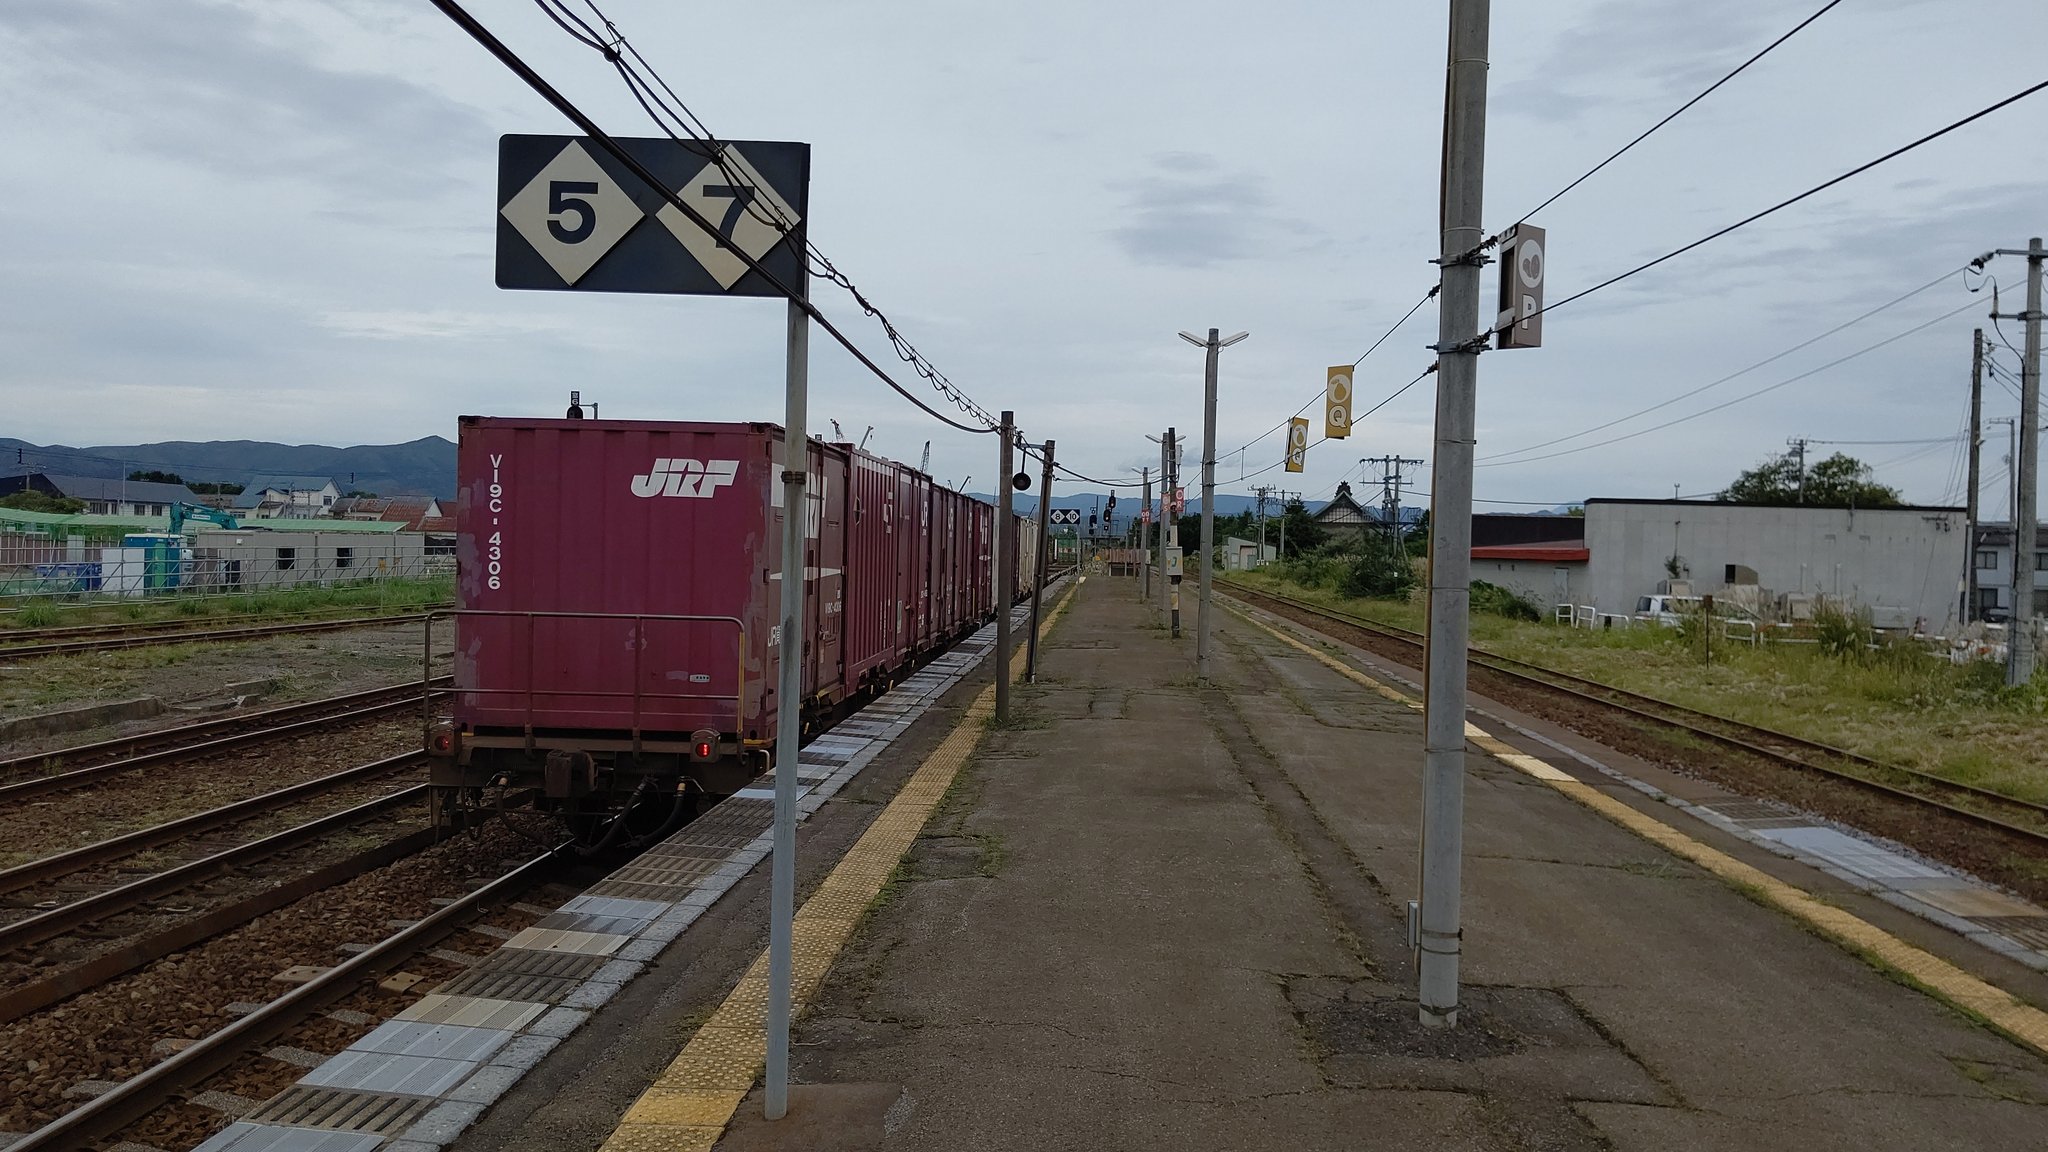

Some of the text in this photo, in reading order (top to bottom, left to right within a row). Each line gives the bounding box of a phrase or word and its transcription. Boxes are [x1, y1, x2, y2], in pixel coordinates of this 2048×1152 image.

[547, 180, 755, 249] 5 7
[1521, 293, 1537, 330] P
[1328, 405, 1347, 428] Q
[1292, 447, 1303, 466] Q
[630, 458, 740, 499] JRF
